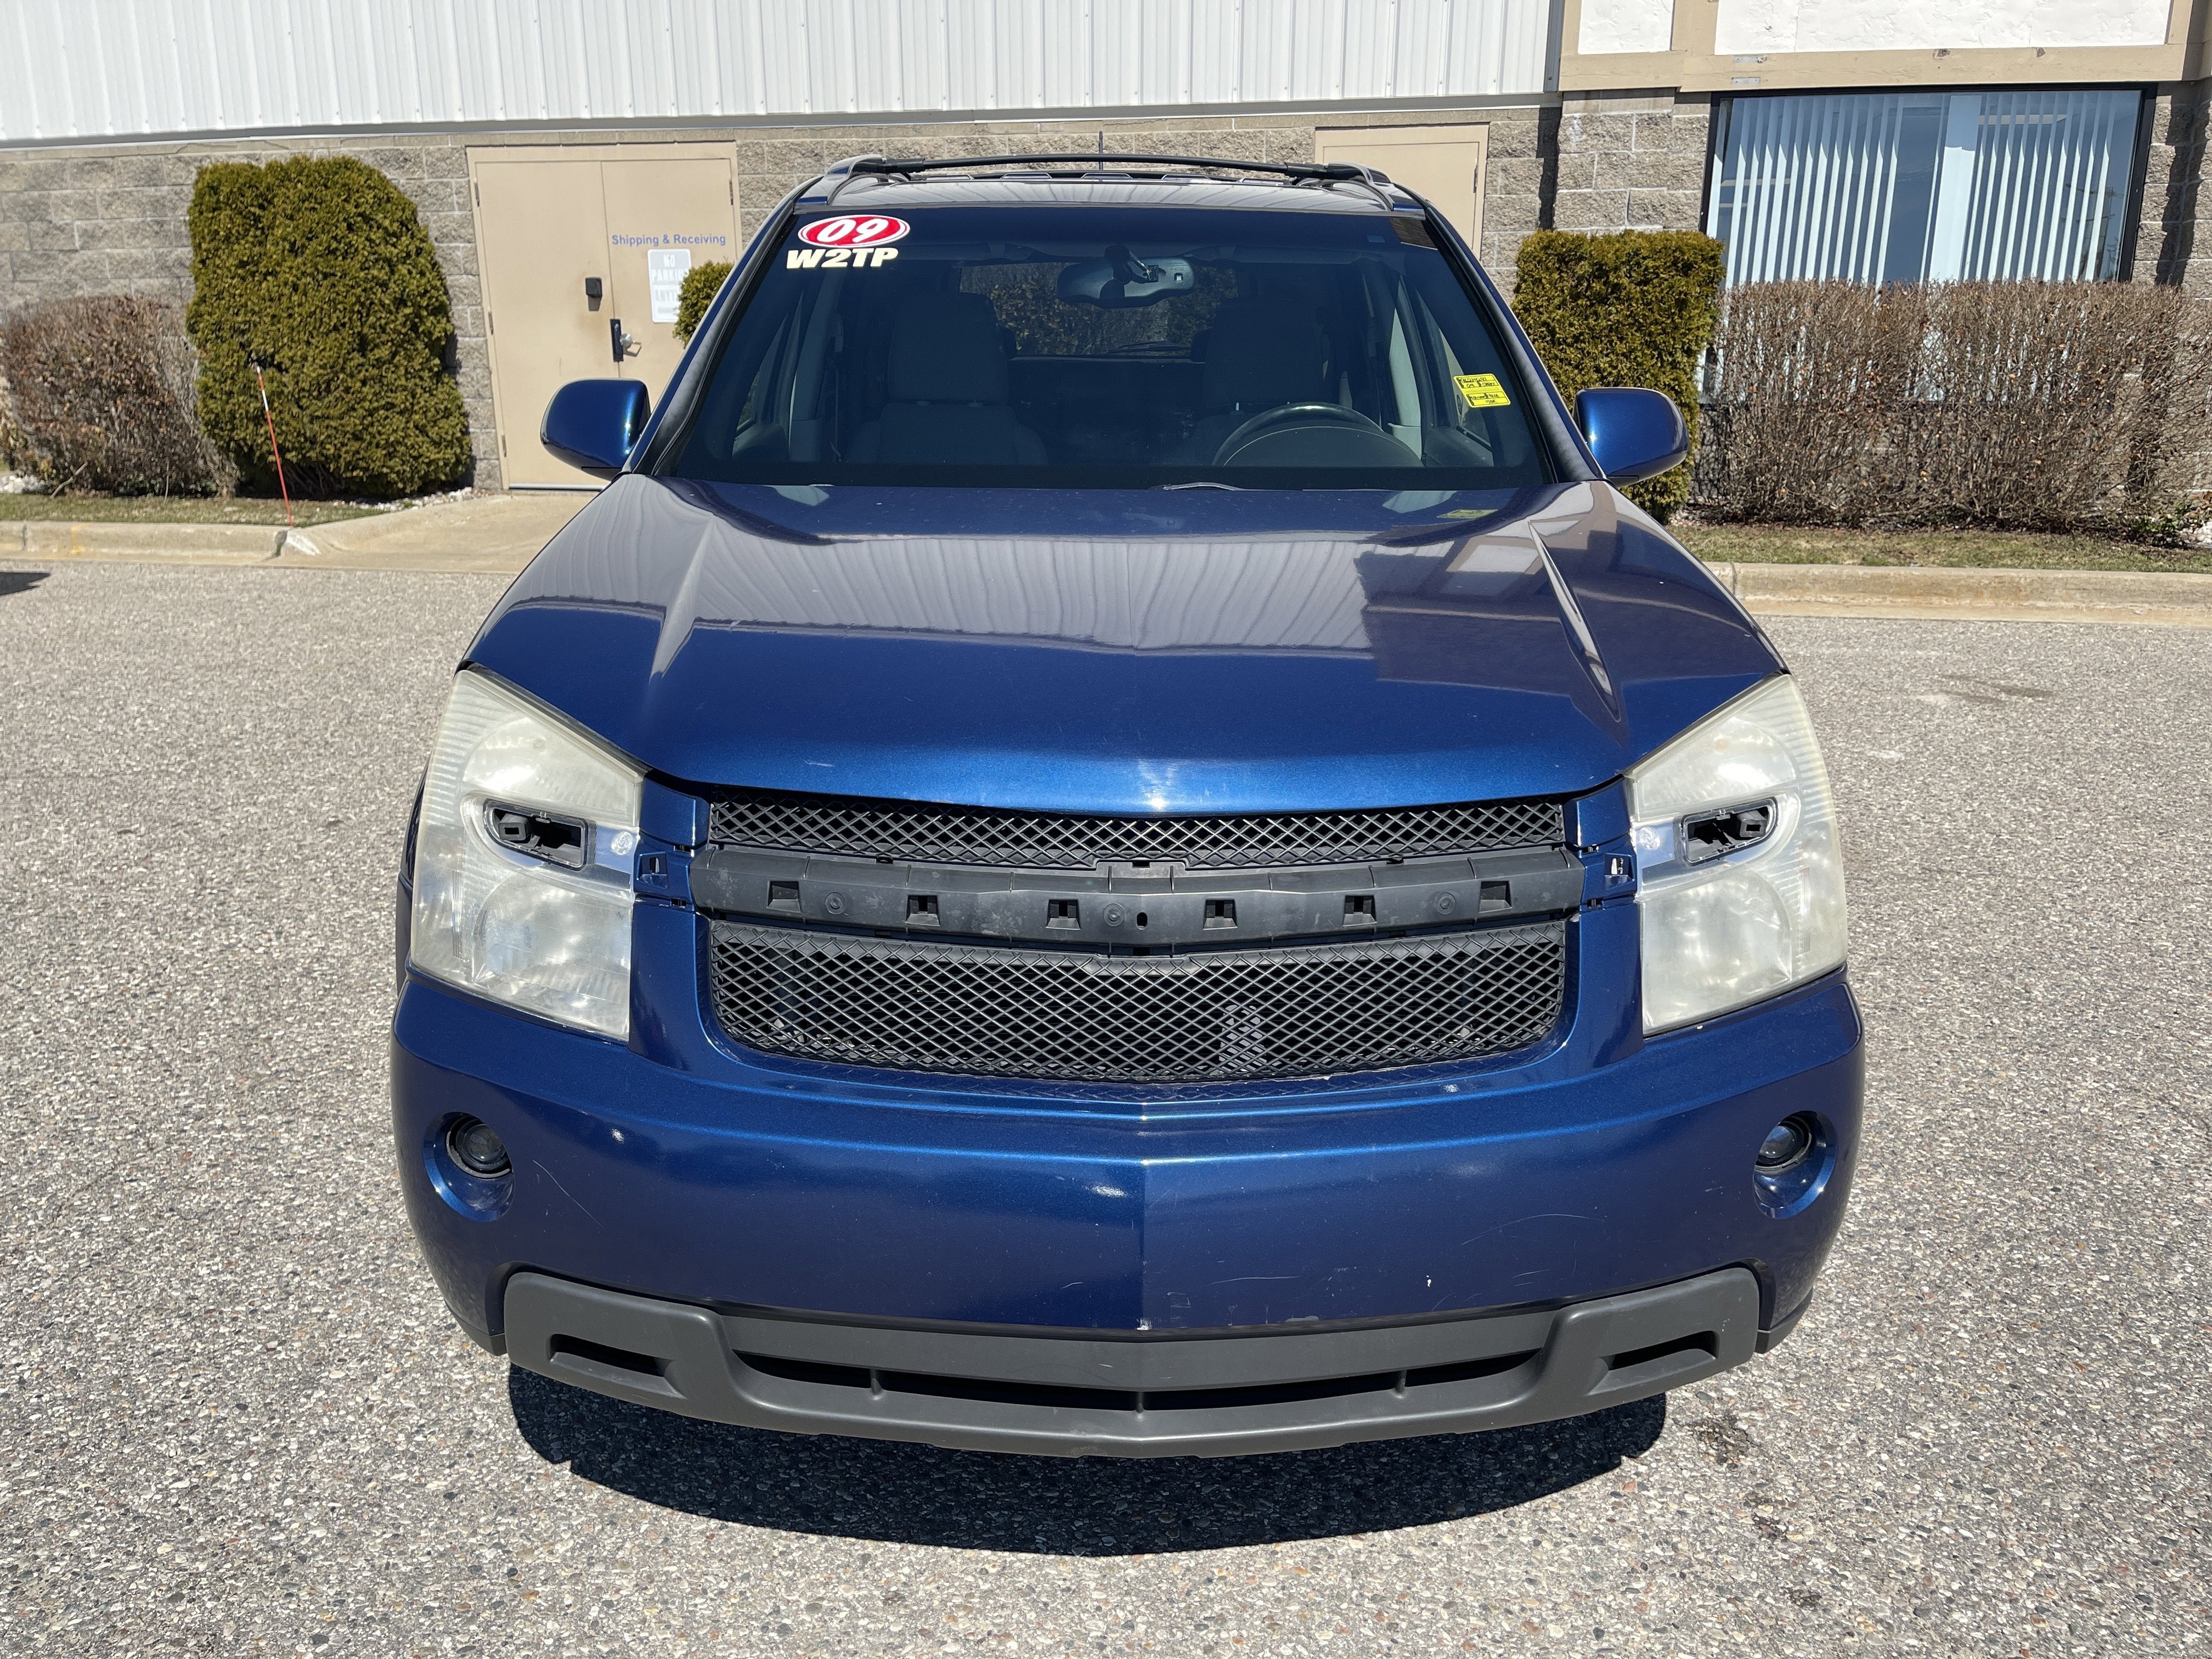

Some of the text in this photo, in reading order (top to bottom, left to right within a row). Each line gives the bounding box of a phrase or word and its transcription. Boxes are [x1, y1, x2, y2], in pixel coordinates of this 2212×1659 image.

[817, 218, 889, 242] 09
[612, 233, 726, 246] Shipping & Receiving
[663, 255, 675, 268] NO
[786, 247, 899, 269] W2TP
